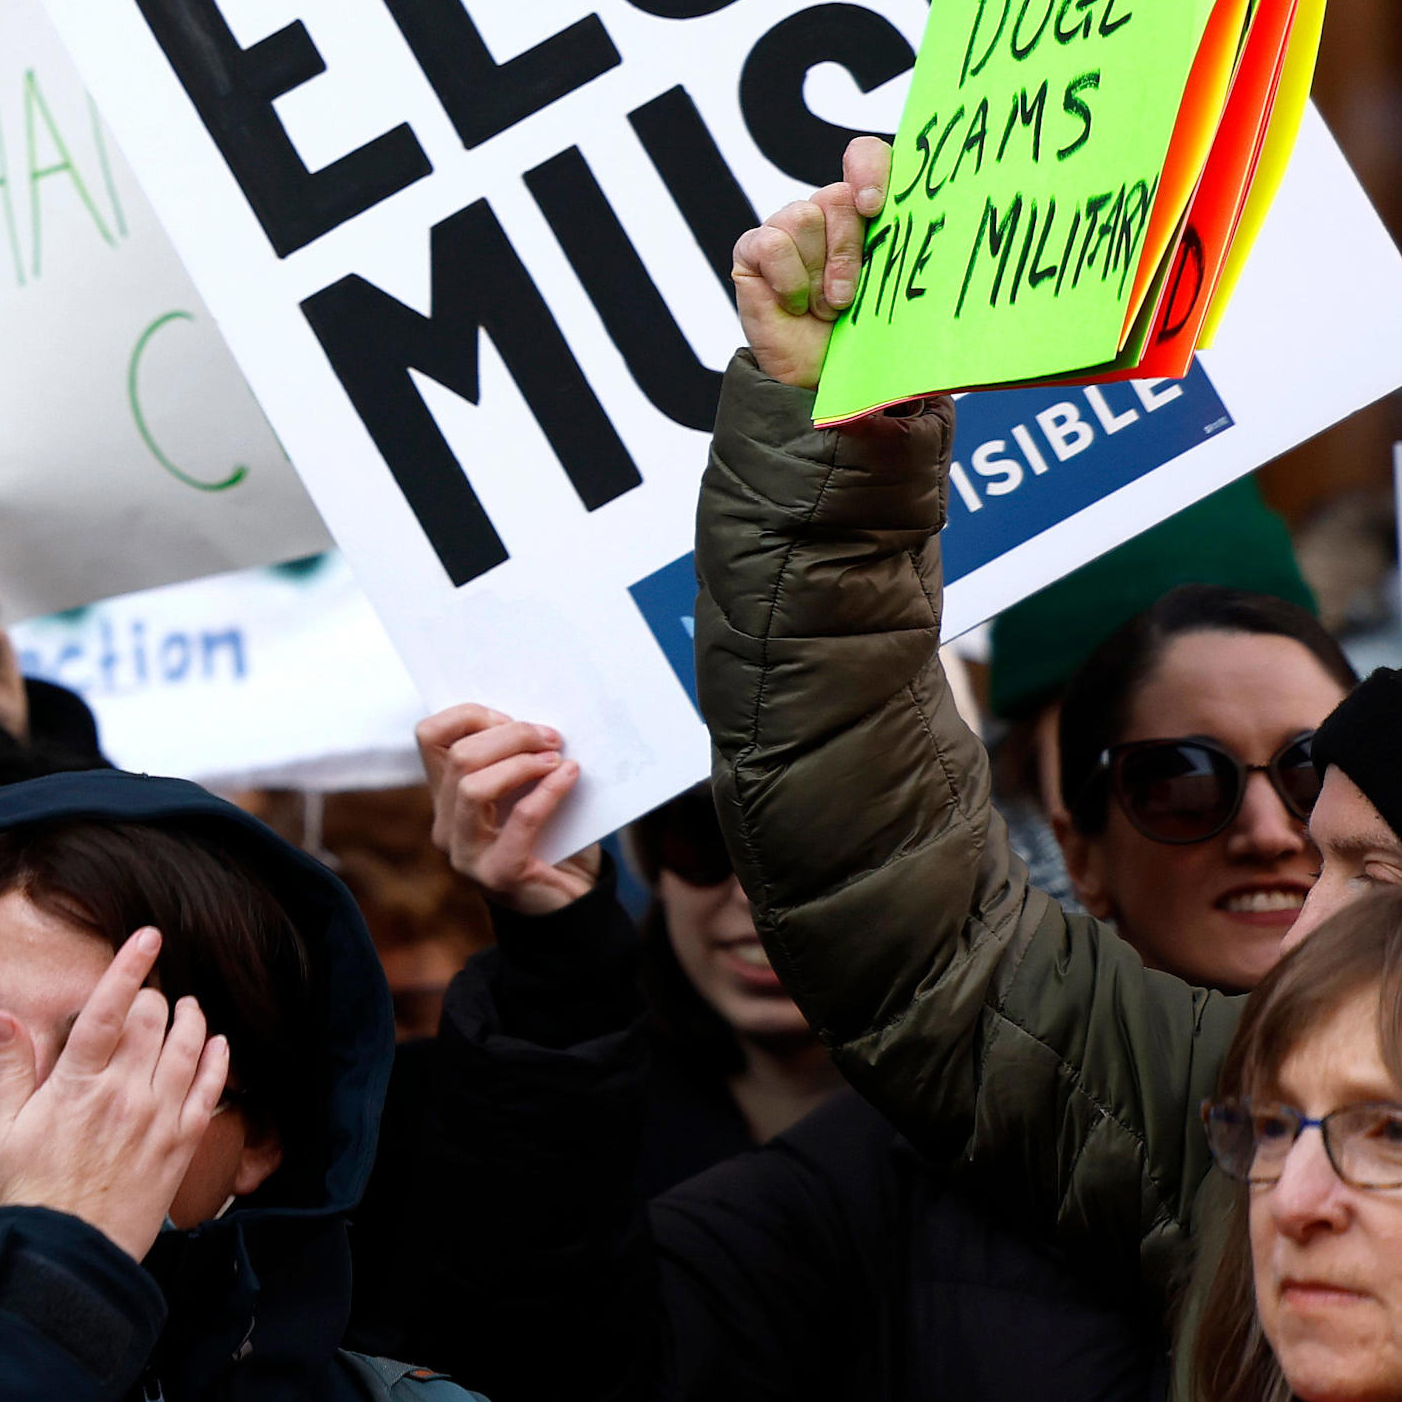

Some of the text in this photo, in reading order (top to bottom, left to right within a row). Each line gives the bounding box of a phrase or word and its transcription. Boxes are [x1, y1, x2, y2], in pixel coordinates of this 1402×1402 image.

[894, 67, 1102, 206] SCAMS
[851, 211, 947, 327] THE
[946, 370, 1186, 526] ISIBLE
